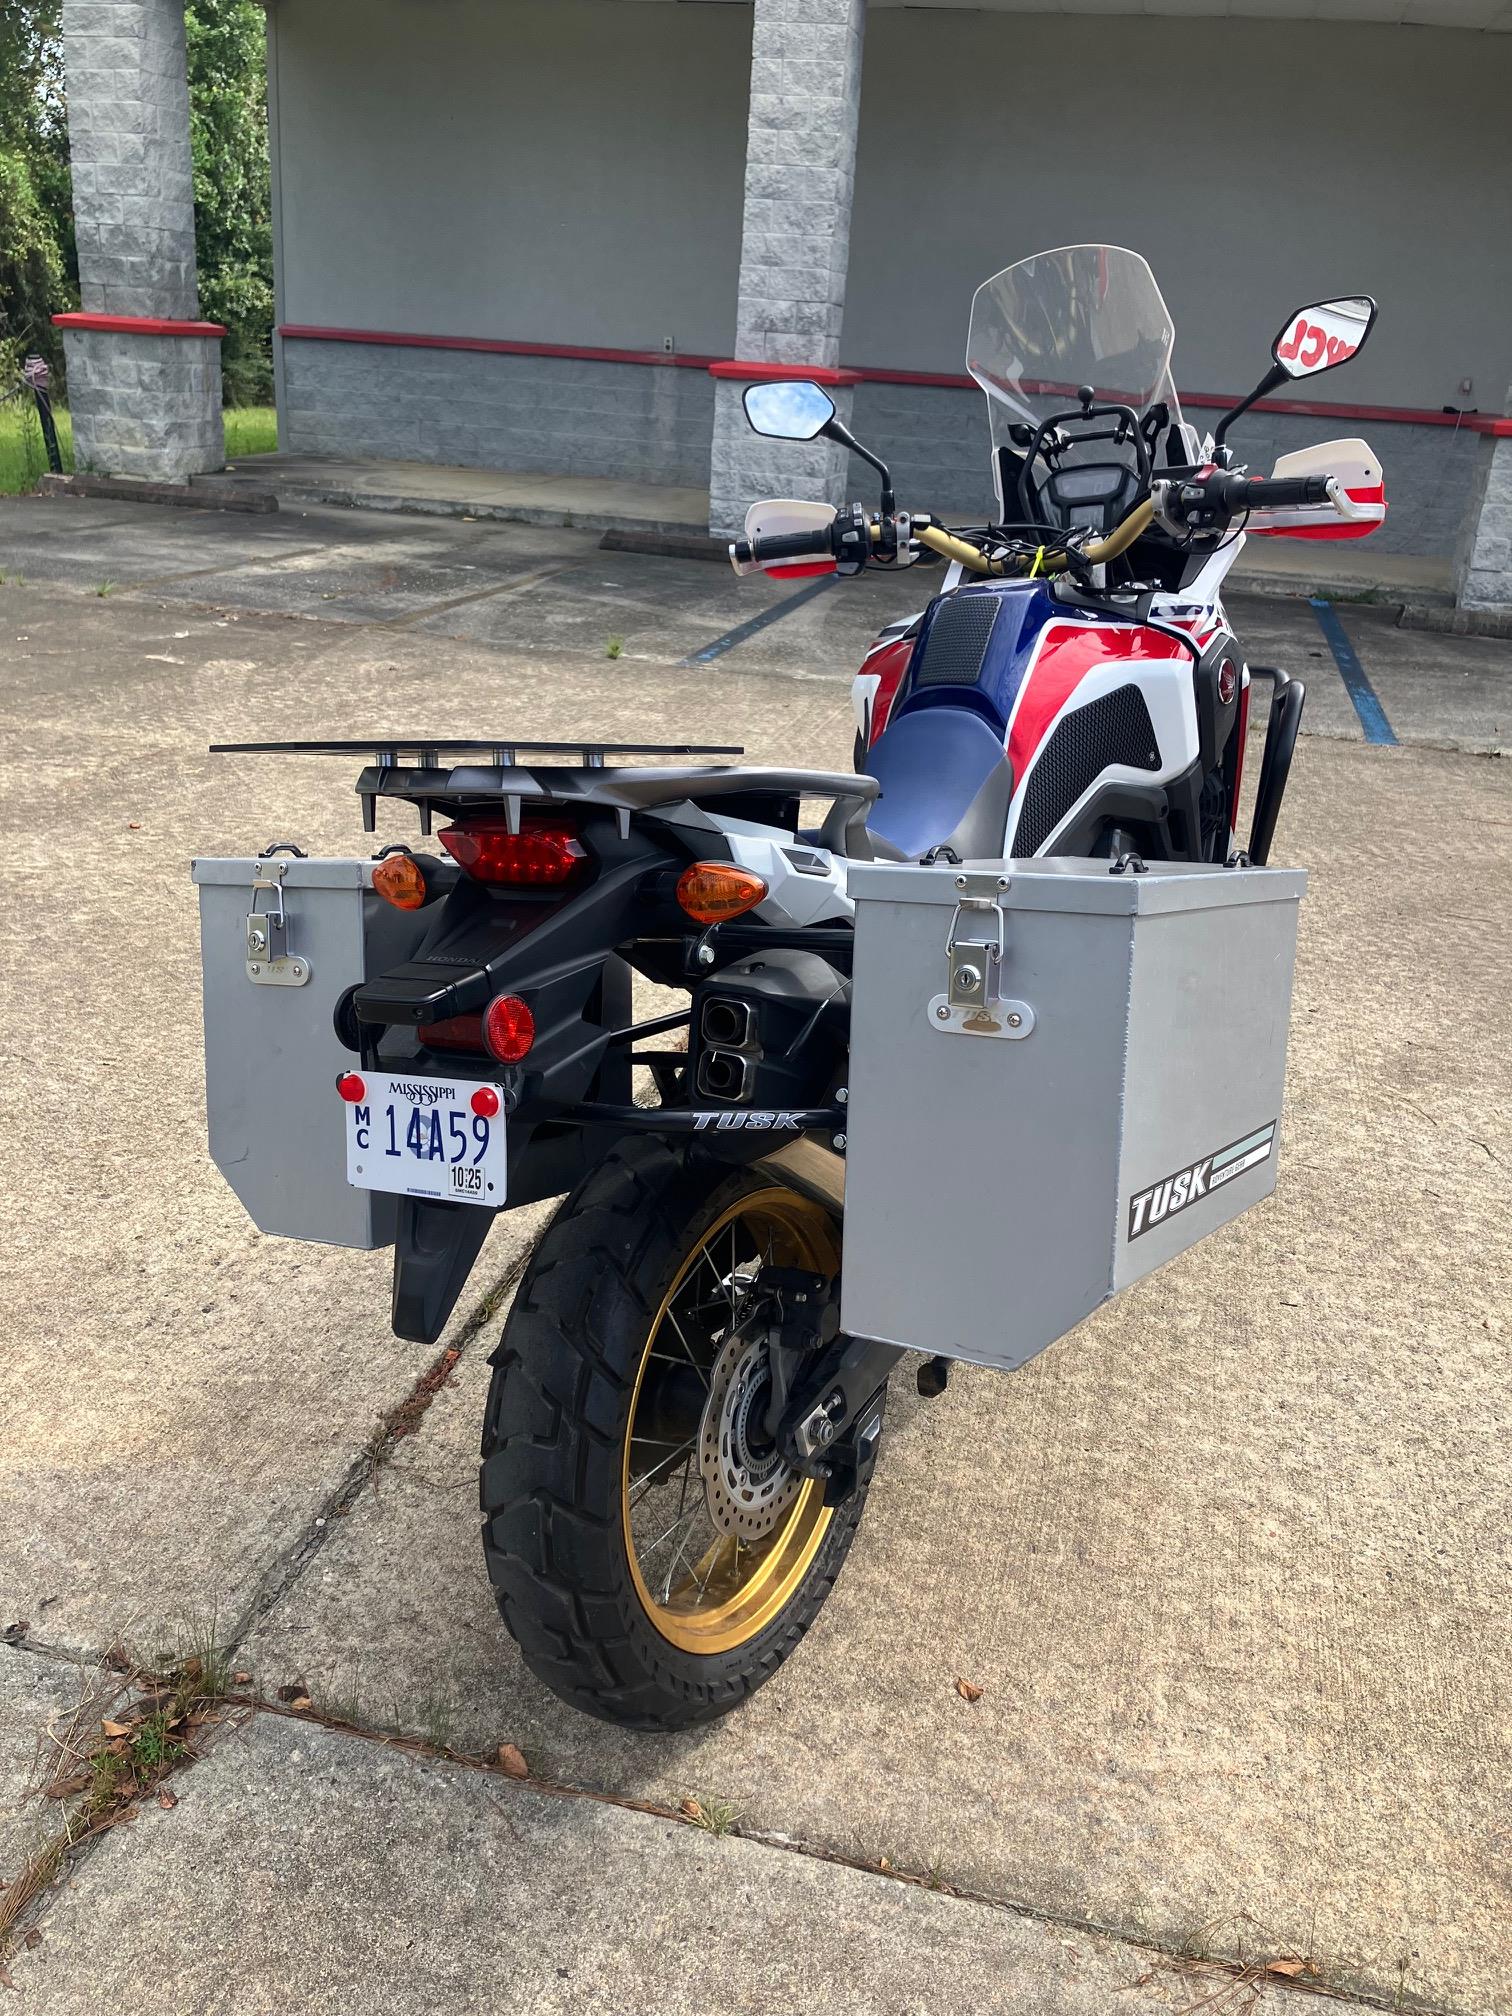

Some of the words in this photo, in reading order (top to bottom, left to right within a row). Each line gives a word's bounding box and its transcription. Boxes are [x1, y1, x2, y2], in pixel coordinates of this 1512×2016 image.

[389, 1082, 456, 1106] MISSISSIPPI
[386, 1105, 490, 1166] 14A59
[693, 1112, 807, 1130] TUSK
[1131, 1157, 1213, 1236] TUSK
